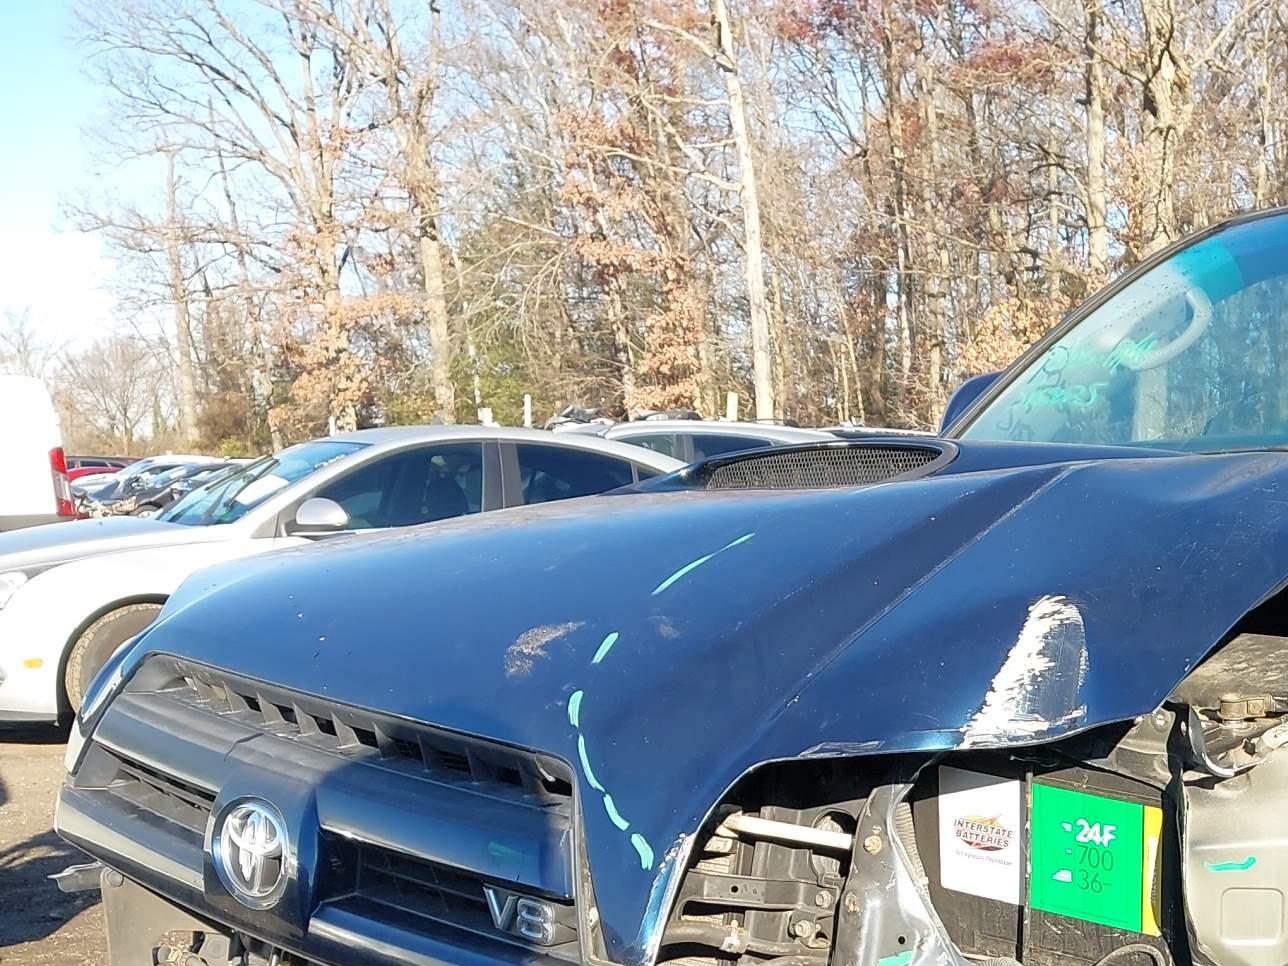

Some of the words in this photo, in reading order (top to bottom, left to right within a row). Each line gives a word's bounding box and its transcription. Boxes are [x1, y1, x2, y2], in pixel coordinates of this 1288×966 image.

[953, 817, 1014, 839] INTERSTATE
[955, 829, 1009, 848] BATTERIES
[1073, 816, 1118, 849] 24F
[1077, 844, 1114, 872] 700
[482, 884, 556, 946] V8
